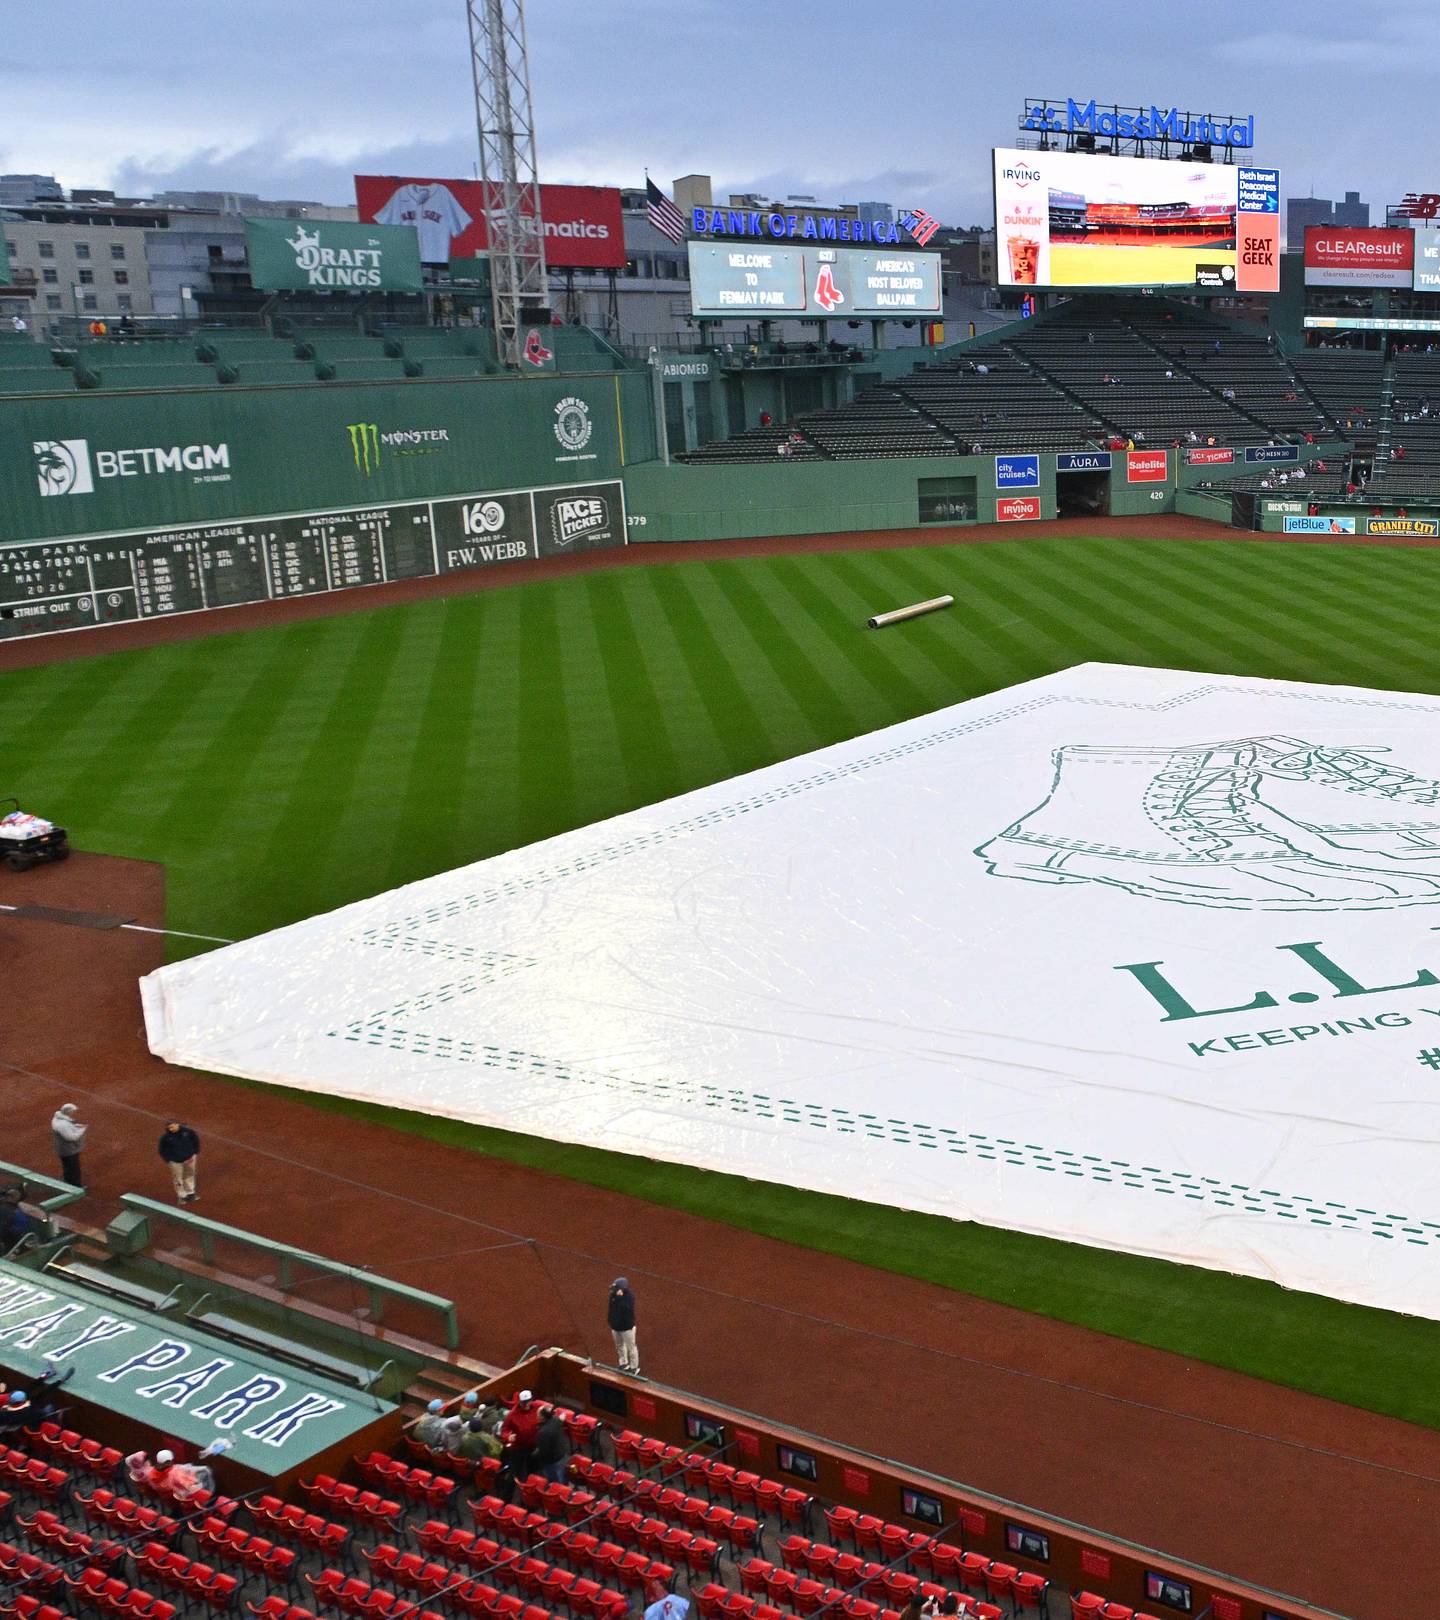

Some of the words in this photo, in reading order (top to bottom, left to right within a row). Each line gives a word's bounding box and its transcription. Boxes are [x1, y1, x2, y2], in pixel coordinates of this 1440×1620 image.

[1067, 98, 1254, 147] MassMutual
[1003, 169, 1040, 181] IRVING
[1239, 170, 1256, 180] Beth
[1257, 172, 1275, 181] Israel
[1239, 181, 1276, 191] Deaconess
[1239, 191, 1266, 200] Medical
[1239, 200, 1263, 210] Center
[422, 209, 443, 224] SOX
[693, 208, 763, 236] BANK
[769, 213, 798, 238] OF
[803, 217, 900, 244] AMERICA
[1244, 238, 1272, 251] SEAT
[1315, 240, 1402, 255] CLEAResult
[296, 245, 382, 270] DRAFT
[1242, 252, 1273, 266] GEEK
[1424, 248, 1438, 257] WE
[728, 253, 772, 269] WELCOME
[876, 260, 915, 273] AMERICA'S
[308, 267, 382, 287] KINGS
[745, 272, 758, 286] TO
[867, 276, 888, 289] MOST
[890, 277, 923, 289] BELOVED
[719, 290, 758, 304] FENWAY
[760, 291, 785, 305] PARK
[876, 293, 916, 306] BALLPARK
[663, 363, 709, 376] ABIOMED
[381, 430, 449, 445] MONSTER
[96, 443, 230, 478] BETMGM
[1206, 451, 1232, 462] TICKET
[999, 463, 1013, 472] city
[1129, 460, 1165, 470] Safelite
[999, 471, 1026, 479] cruises
[1150, 491, 1164, 500] 420
[561, 499, 603, 523] ACE
[1003, 505, 1034, 514] IRVING
[1267, 502, 1289, 512] DICK'S
[309, 515, 353, 526] NATIONAL
[355, 510, 390, 521] LEAGUE
[462, 500, 505, 535] 160
[564, 514, 603, 534] TICKET
[627, 516, 647, 526] 379
[1288, 518, 1325, 531] jetBlue
[1369, 520, 1412, 533] GRANITE
[1414, 520, 1437, 534] CITY
[146, 532, 200, 545] AMERICAN
[204, 527, 243, 538] LEAGUE
[42, 543, 89, 557] PARK
[447, 547, 478, 568] F.W.
[478, 540, 528, 563] WEBB
[75, 555, 86, 565] 10
[15, 572, 42, 584] MAY
[155, 575, 171, 585] SEA
[13, 605, 47, 619] STRIKE
[49, 602, 71, 613] OUT
[1185, 1011, 1412, 1057] KEEPING
[97, 1339, 347, 1447] PARK
